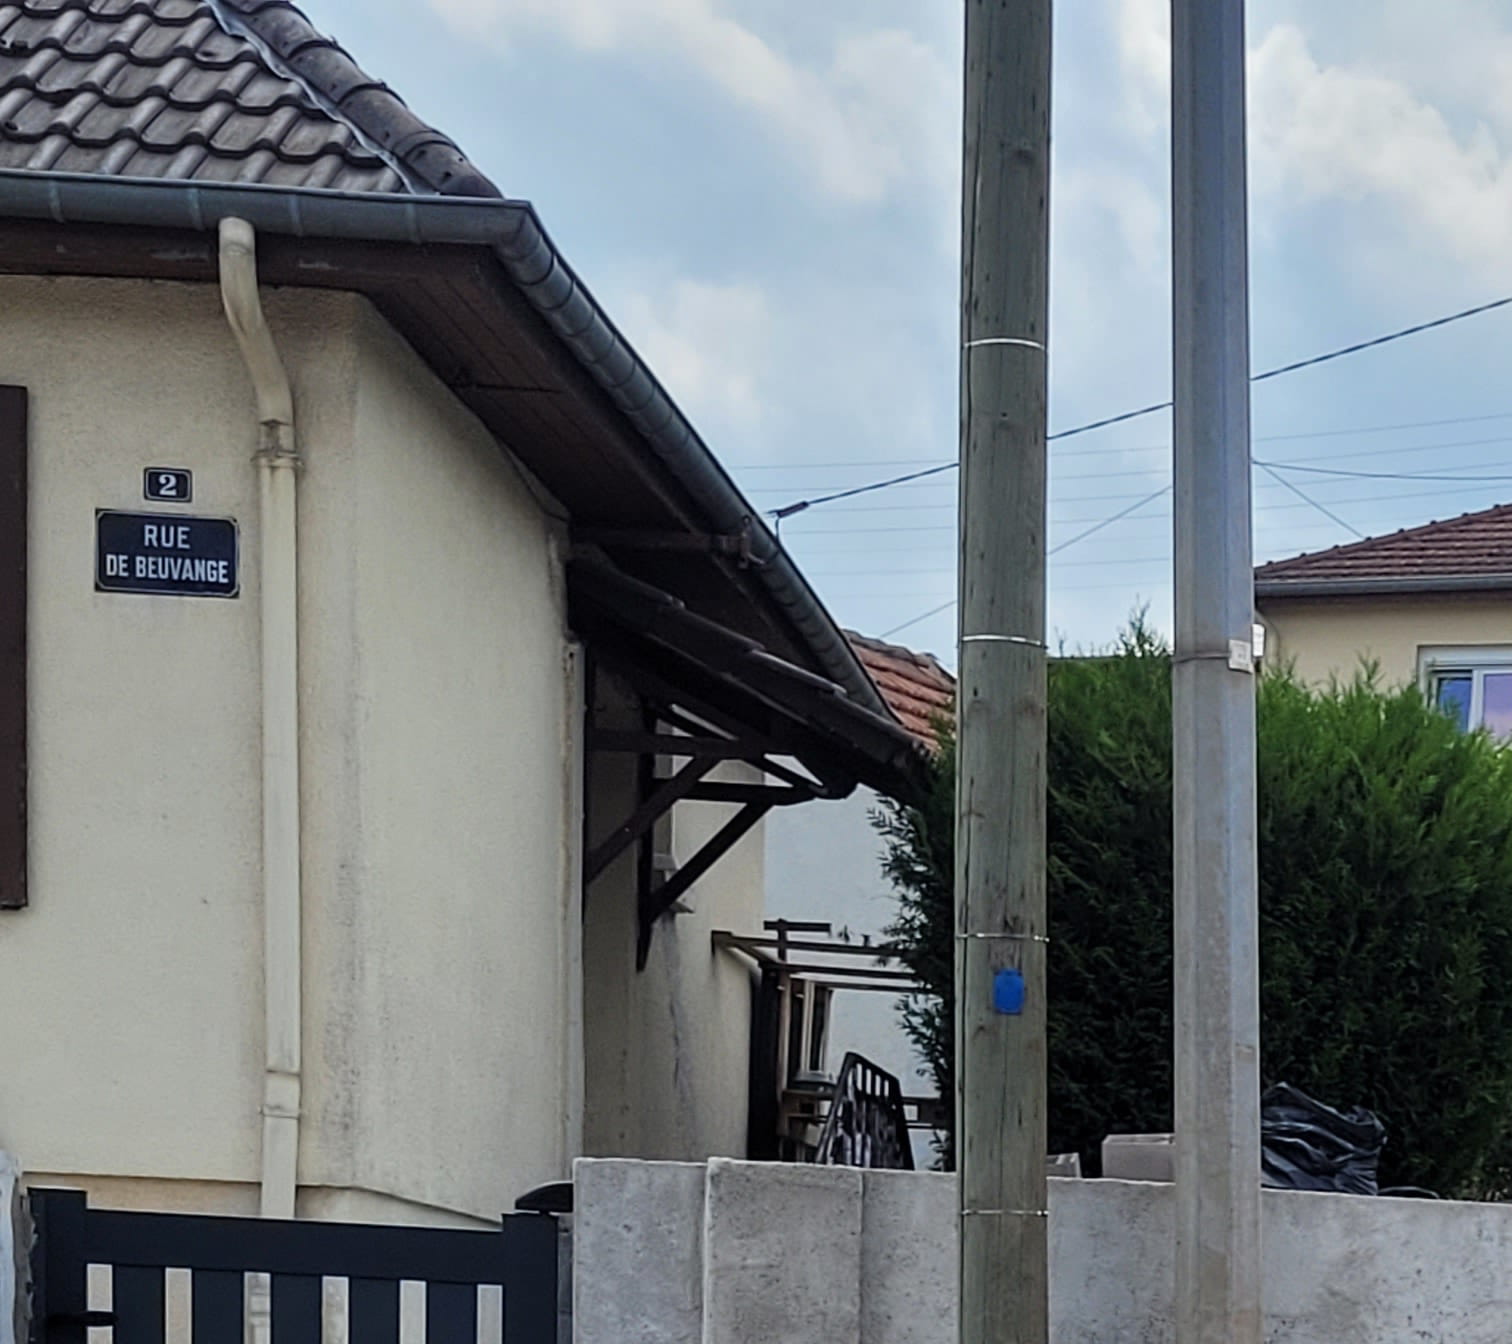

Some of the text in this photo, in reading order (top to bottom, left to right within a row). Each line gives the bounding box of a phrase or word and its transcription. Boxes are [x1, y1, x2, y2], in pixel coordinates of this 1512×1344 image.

[158, 474, 177, 496] 2
[144, 524, 191, 549] RUE
[105, 554, 229, 583] DE BEUVANGE
